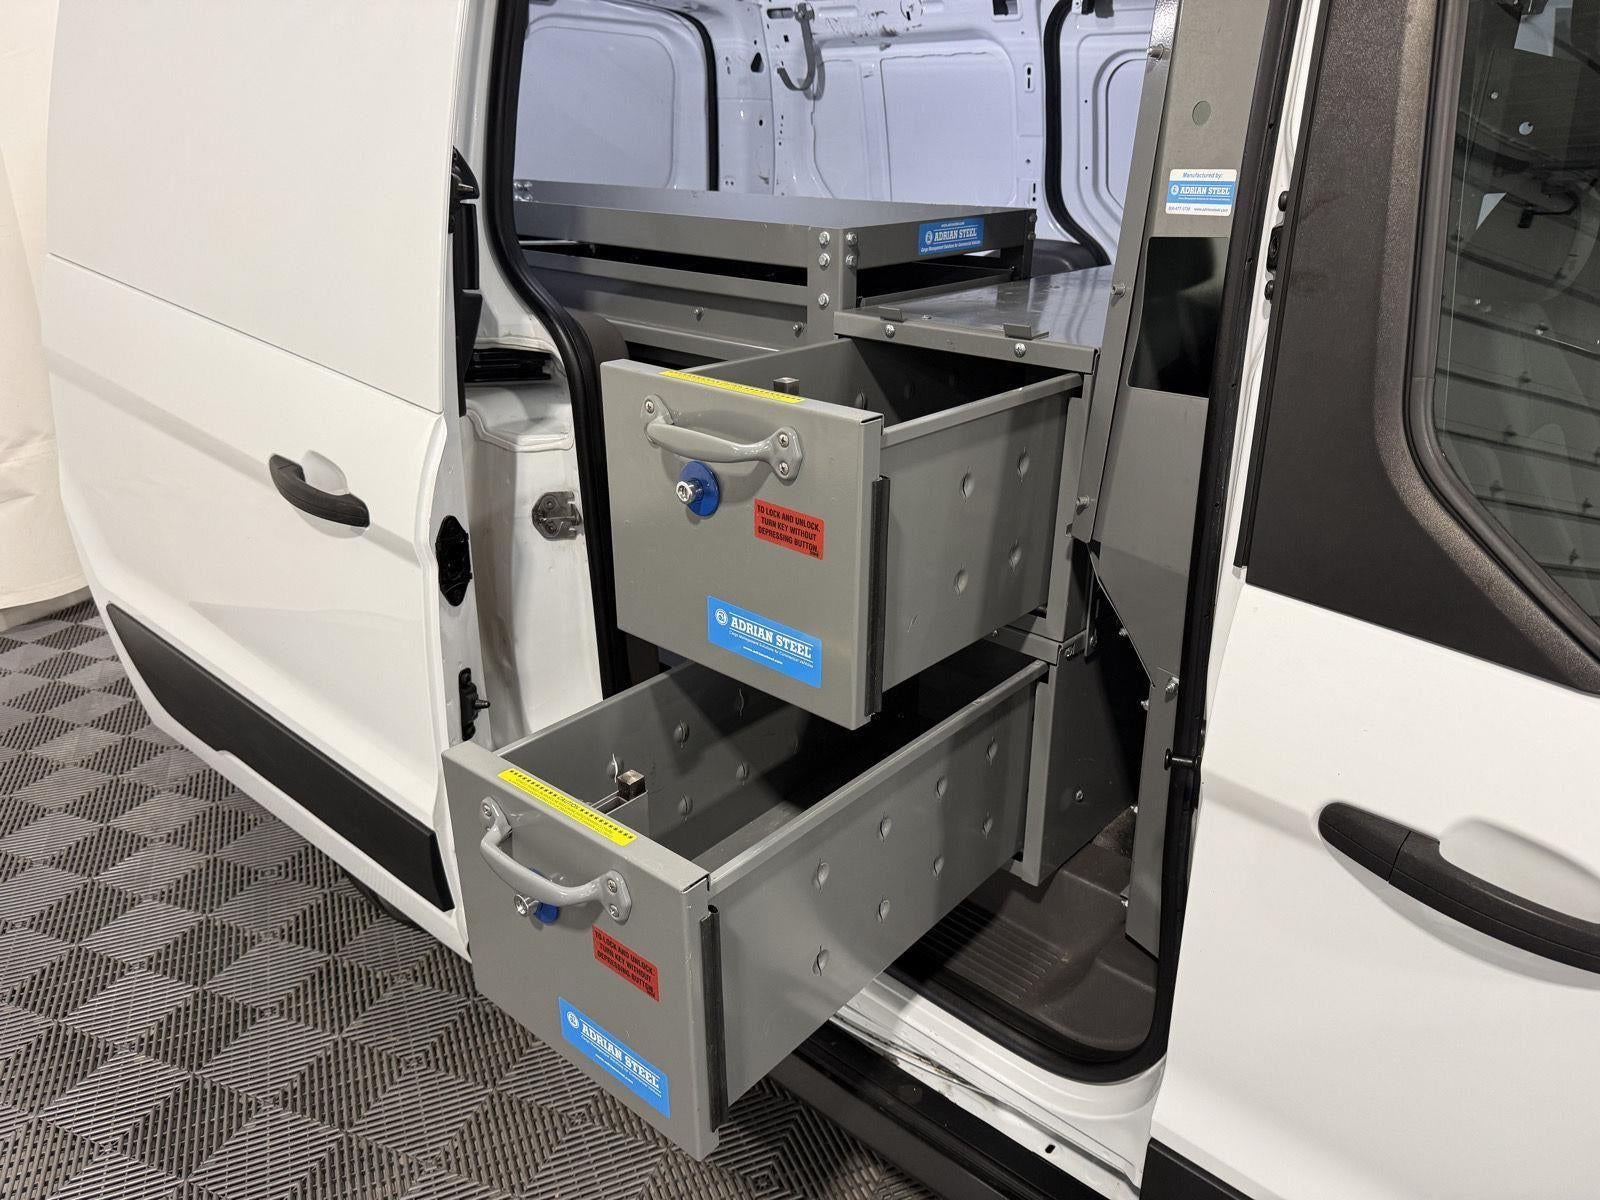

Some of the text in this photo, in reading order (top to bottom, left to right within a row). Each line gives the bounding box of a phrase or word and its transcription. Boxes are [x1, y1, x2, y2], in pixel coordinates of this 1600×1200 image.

[1180, 186, 1231, 195] ADRIAN STEEL
[934, 227, 978, 241] ADRIAN STEEL
[757, 505, 764, 513] TO
[766, 508, 780, 519] LOCK
[782, 513, 794, 523] AND
[758, 526, 793, 544] DEPRESSING
[761, 517, 816, 541] TURN KEY WITHOUT
[731, 616, 812, 659] ADRIAN STEEL
[595, 931, 602, 941] TO
[602, 935, 617, 950] LOCK
[618, 947, 630, 959] AND
[600, 943, 651, 982] TURN KEY WITHOUT
[582, 1023, 660, 1089] ADRIAN STEEL
